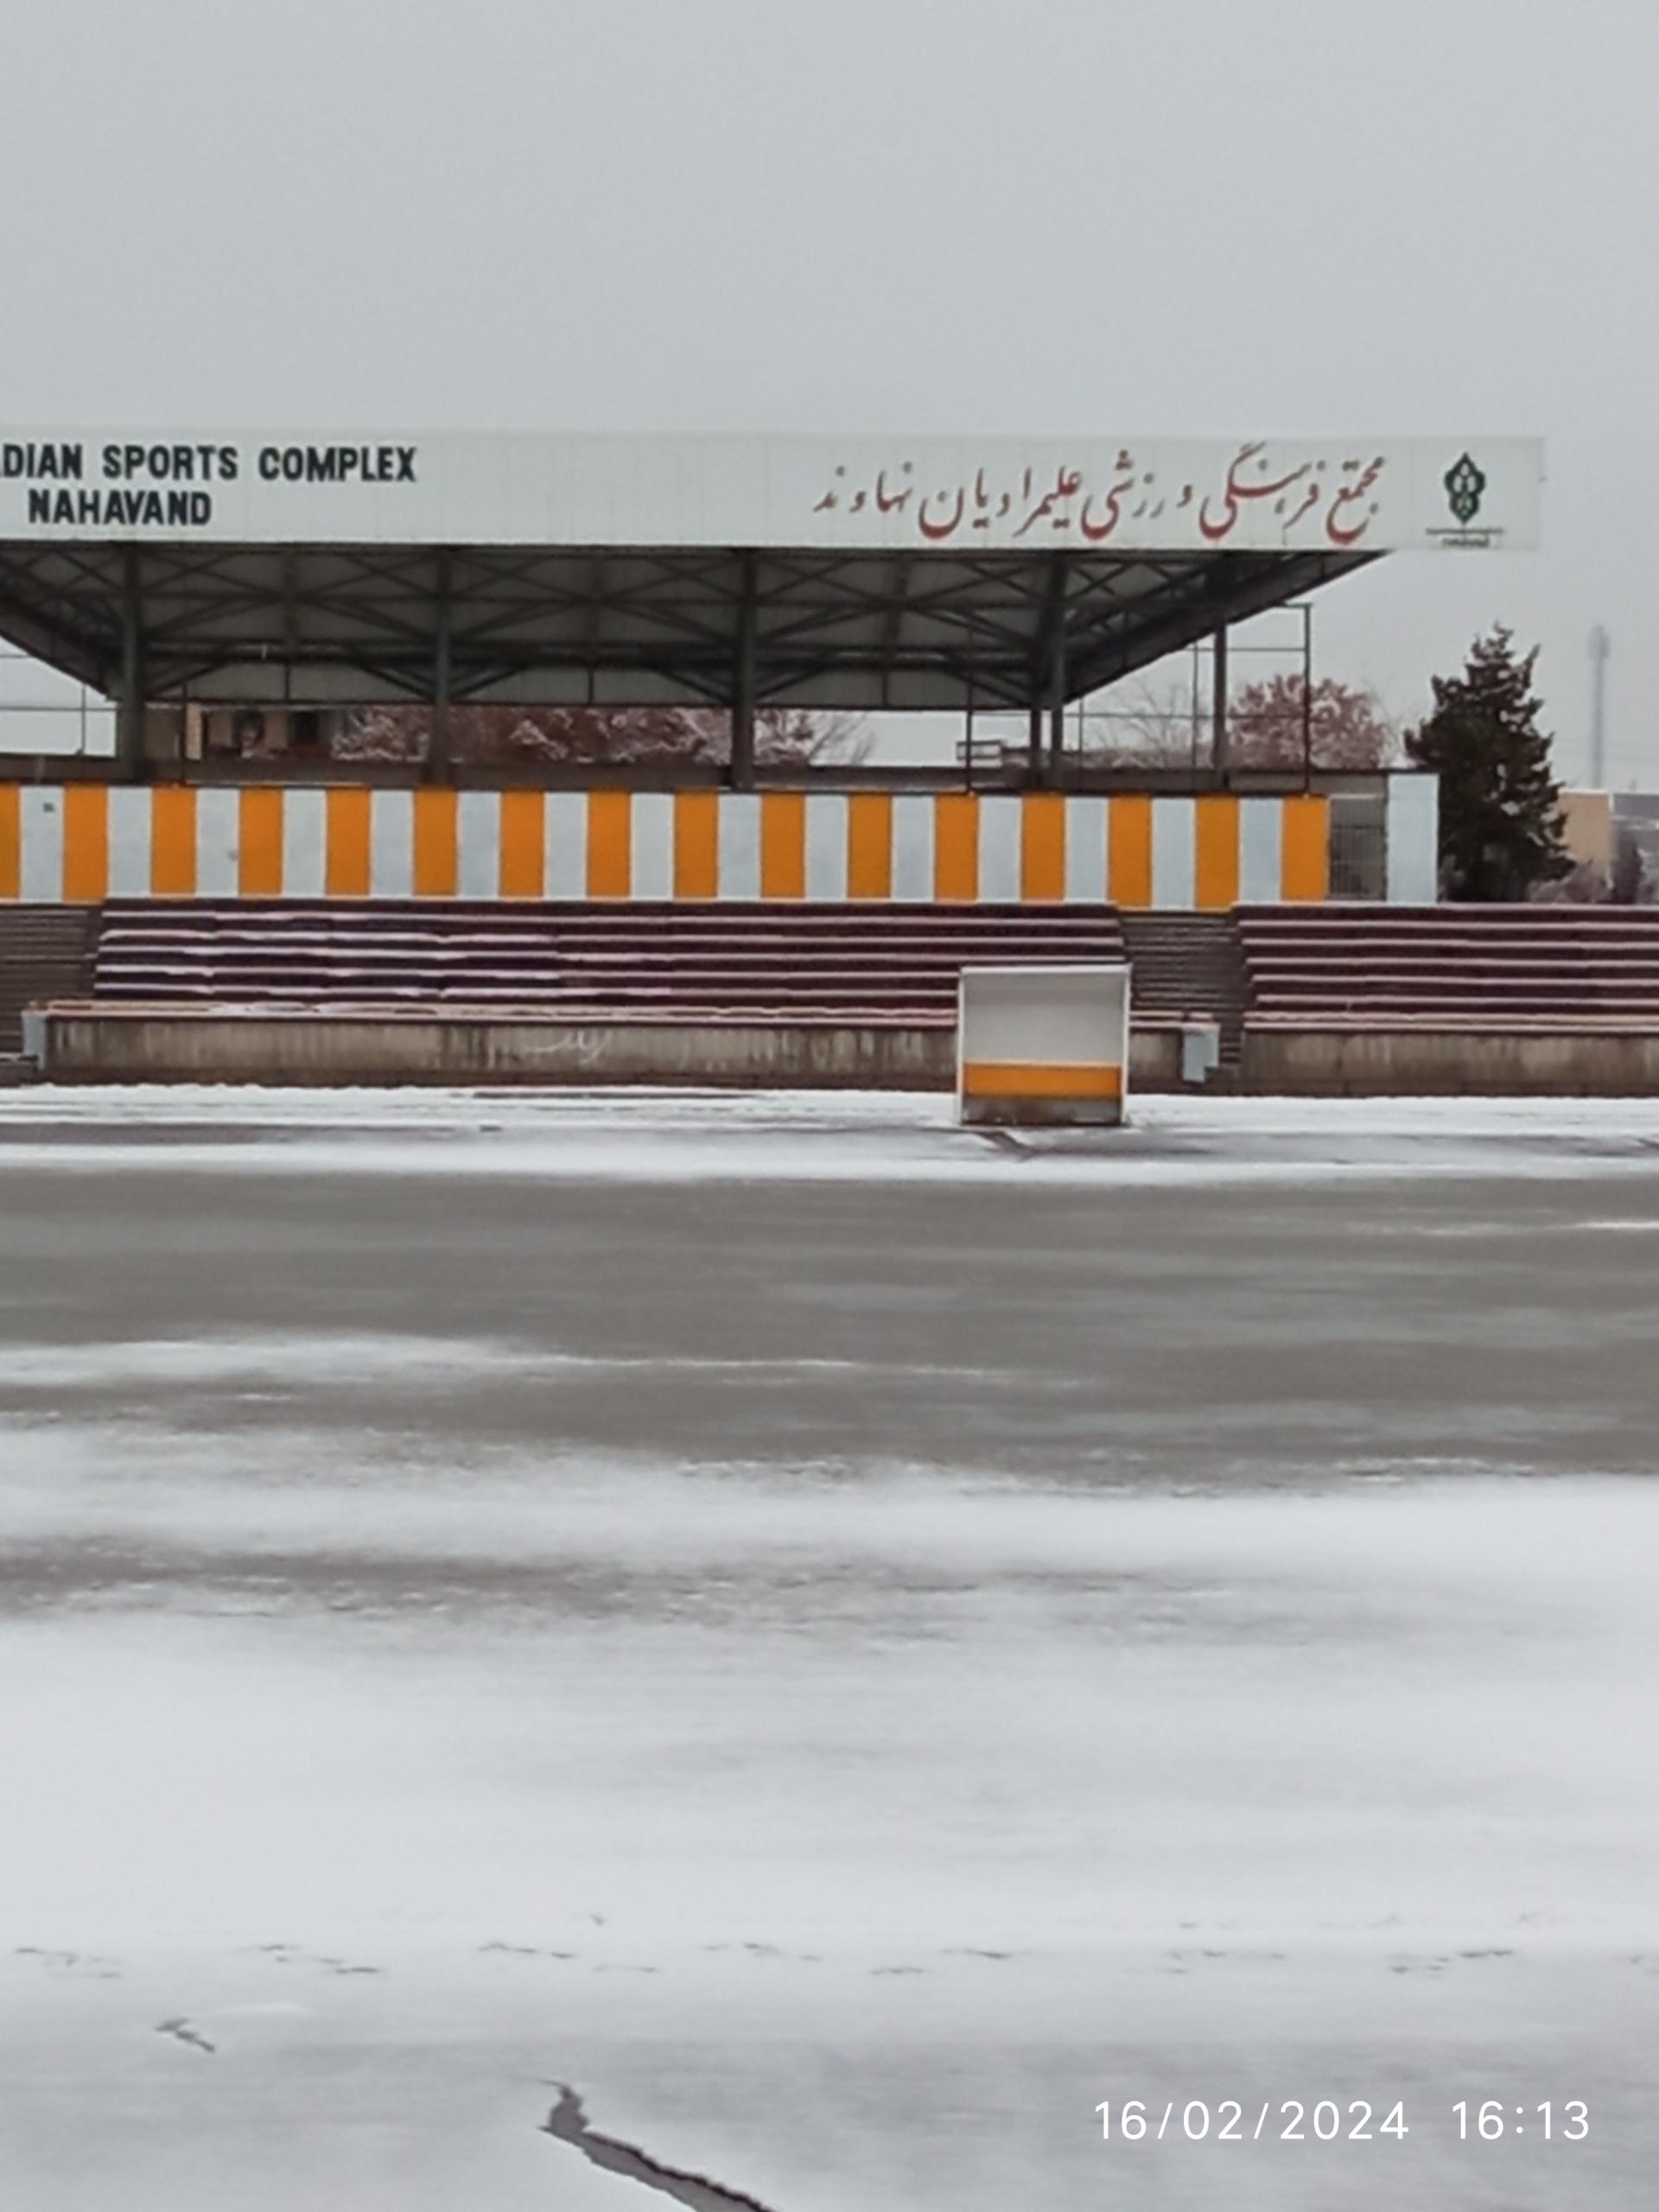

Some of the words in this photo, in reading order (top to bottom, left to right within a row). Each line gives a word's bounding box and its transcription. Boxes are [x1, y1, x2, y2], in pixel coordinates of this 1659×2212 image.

[0, 443, 82, 480] DIAN
[103, 445, 238, 480] SPORTS
[258, 447, 417, 482] COMPLEX
[812, 461, 913, 513] نهاوند
[29, 489, 212, 525] NAHAVAND
[1198, 441, 1325, 542] فرهنگی
[1325, 455, 1385, 544] مجتمع
